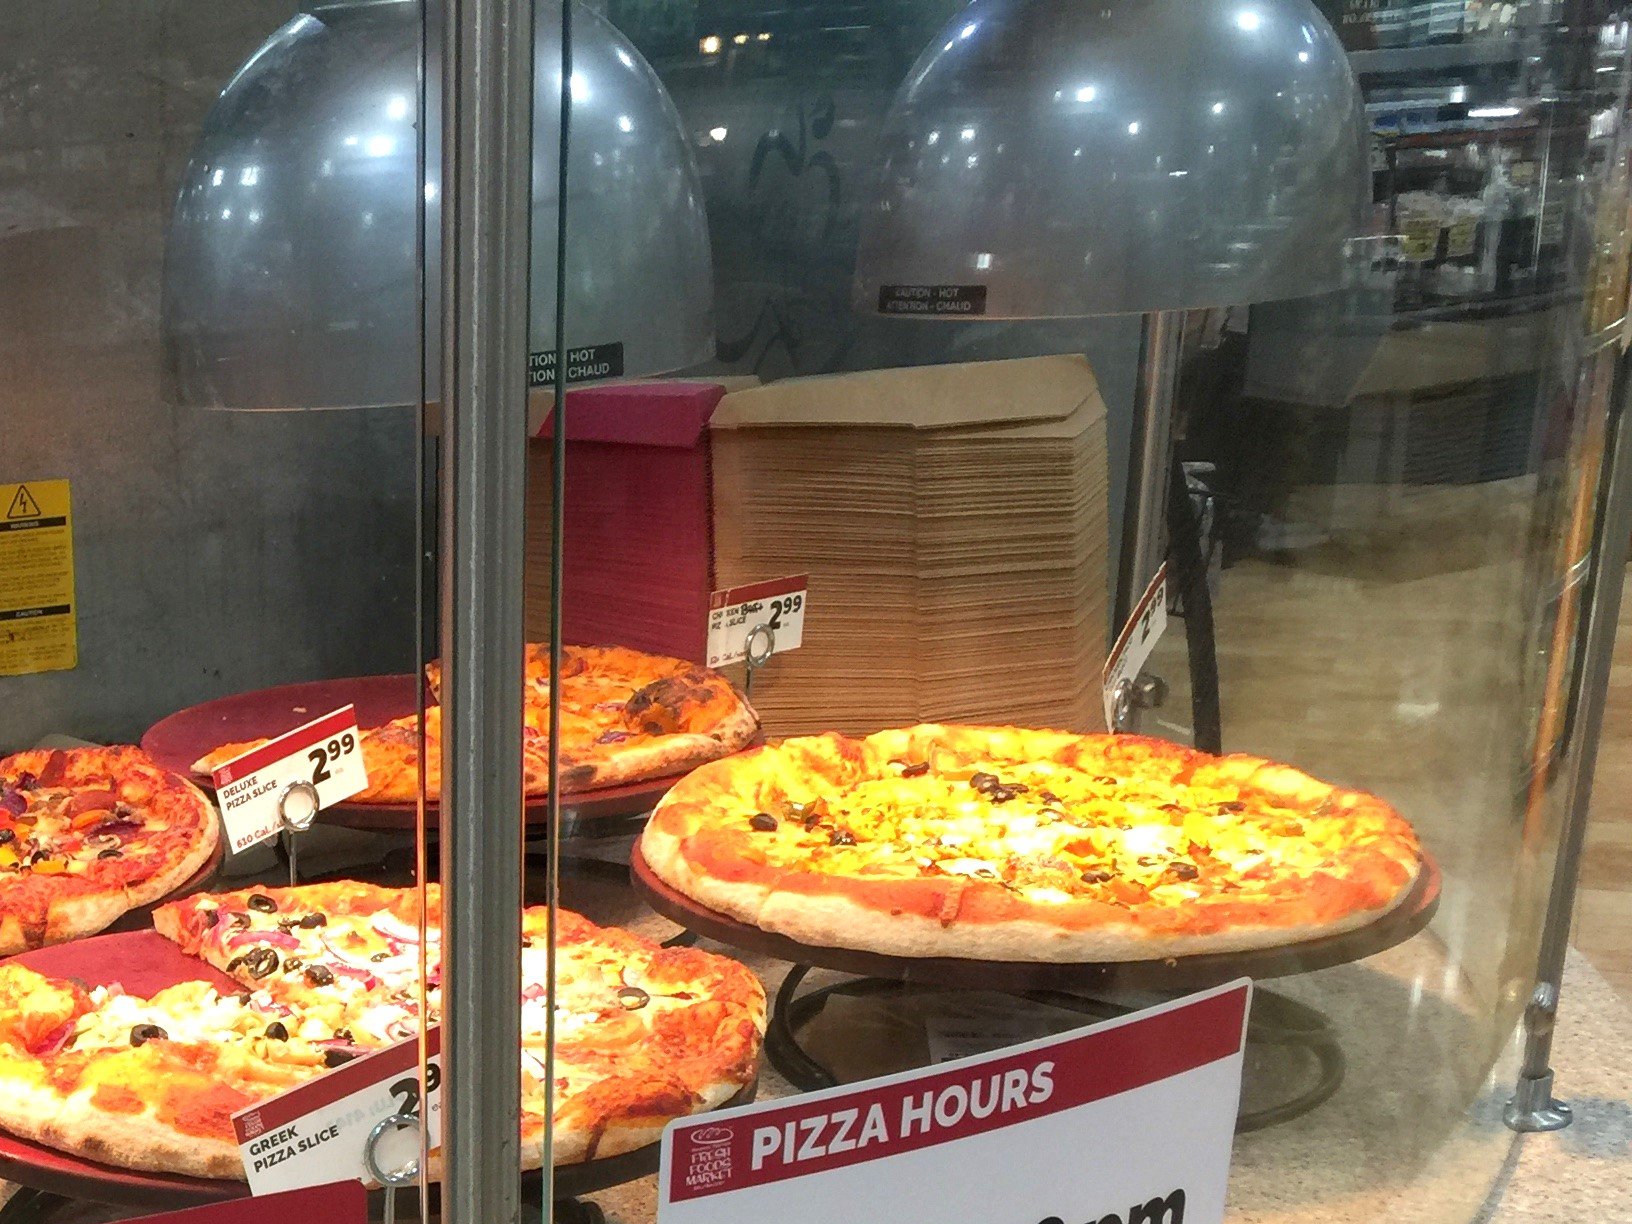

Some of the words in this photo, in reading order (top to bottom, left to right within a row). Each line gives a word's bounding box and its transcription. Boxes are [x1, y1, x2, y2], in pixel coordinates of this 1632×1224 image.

[939, 288, 959, 298] HOT
[570, 349, 596, 363] HOT
[568, 362, 610, 378] CHAUD
[308, 733, 355, 786] 299
[223, 776, 258, 799] DELUXE
[226, 793, 252, 811] PIZZA
[252, 780, 278, 799] SLICE
[236, 835, 253, 849] 610
[750, 1104, 891, 1172] PIZZA
[899, 1061, 1056, 1138] HOURS
[249, 1125, 299, 1157] GREEK
[253, 1148, 297, 1174] PIZZA
[298, 1125, 340, 1153] SLICE
